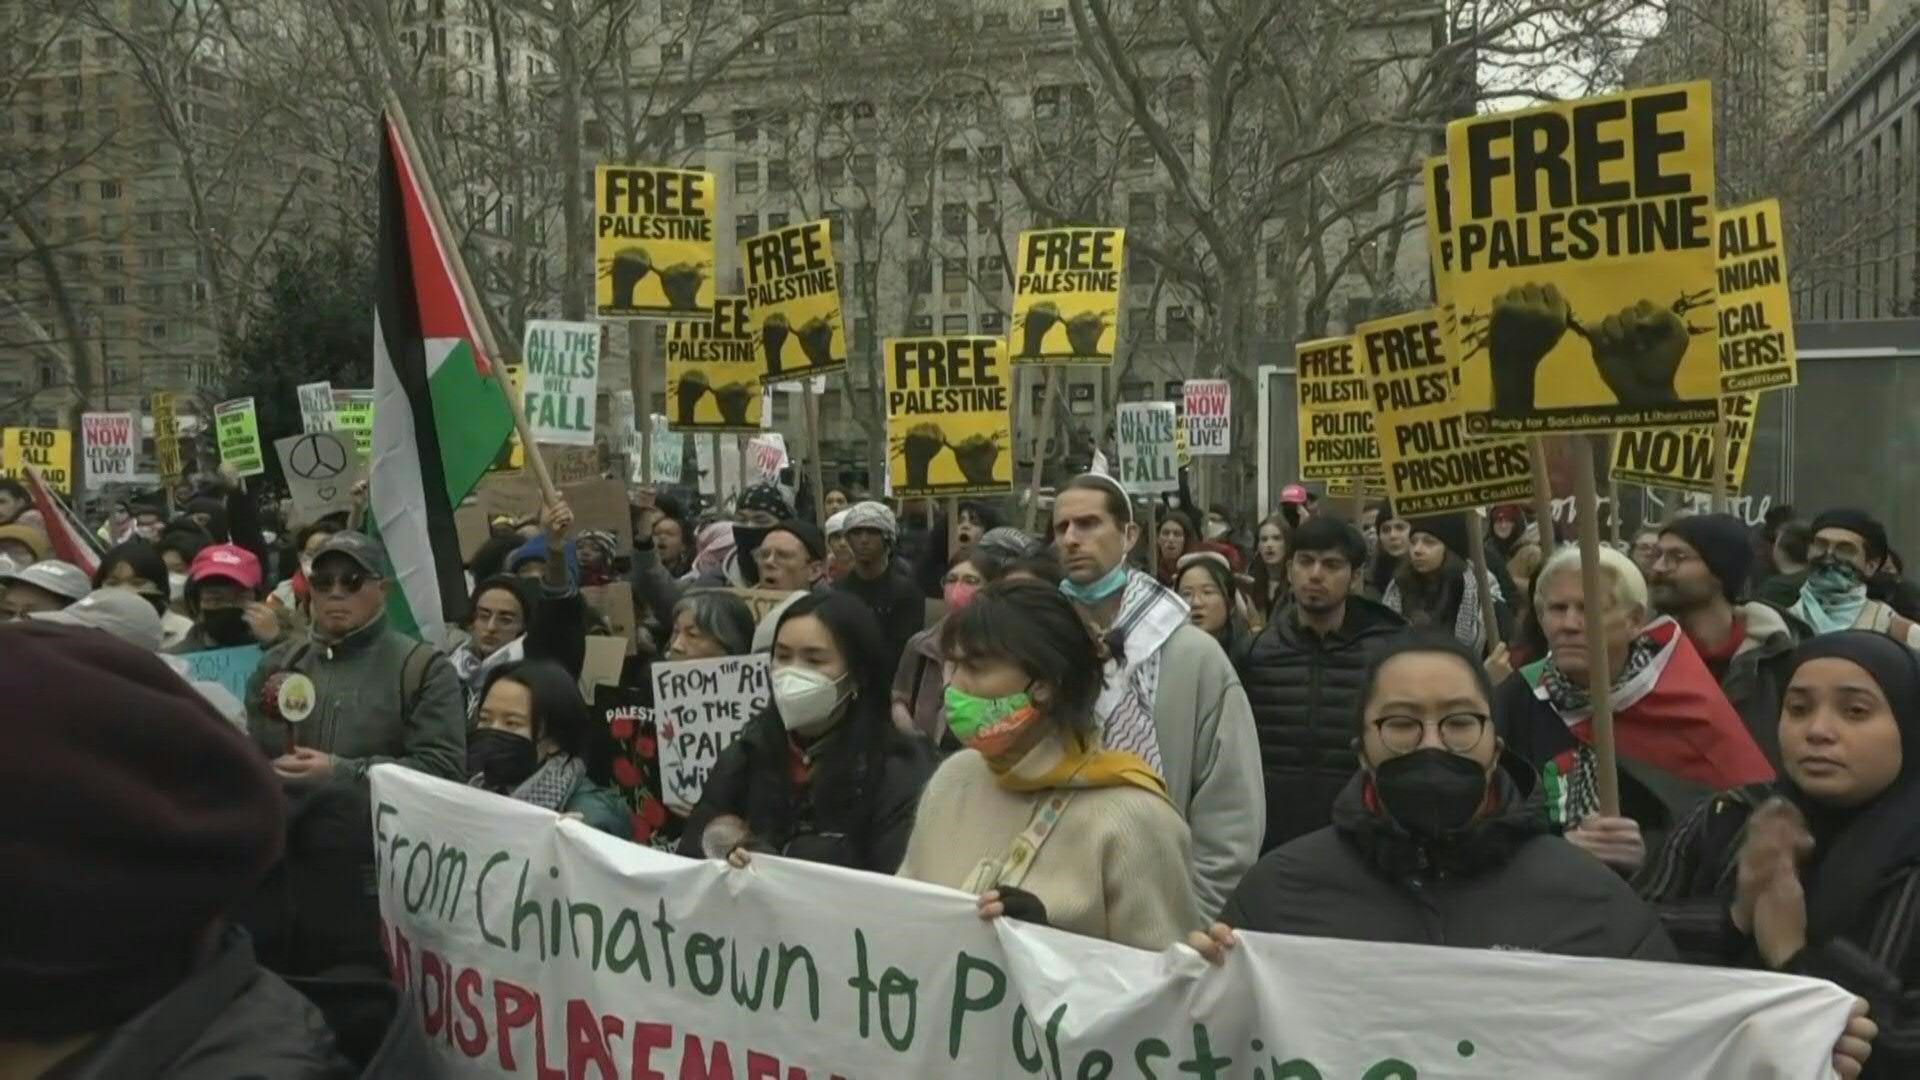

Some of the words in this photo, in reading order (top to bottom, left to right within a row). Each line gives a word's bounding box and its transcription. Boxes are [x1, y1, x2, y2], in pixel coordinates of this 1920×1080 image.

[1467, 91, 1691, 219] FREE
[605, 169, 705, 216] FREE
[599, 215, 711, 242] PALESTINE
[1459, 195, 1710, 272] PALESTINE
[1719, 211, 1777, 260] ALL
[747, 224, 826, 284] FREE
[1026, 231, 1116, 273] FREE
[747, 268, 836, 310] PALESTINE
[1018, 271, 1118, 295] PALESTINE
[528, 328, 559, 350] ALL
[564, 331, 597, 352] THE
[1365, 321, 1446, 376] FREE
[527, 350, 595, 379] WALLS
[894, 340, 1000, 389] FREE
[1300, 345, 1353, 378] FREE
[524, 392, 592, 432] FALL
[890, 387, 1007, 416] PALESTINE
[1187, 397, 1225, 416] NOW
[1615, 411, 1640, 424] and
[18, 430, 55, 448] END
[87, 428, 128, 446] NOW
[1121, 424, 1174, 445] WALLS
[1189, 429, 1223, 447] LIVE!
[1305, 436, 1381, 463] PRISONE
[22, 448, 51, 465] ALL
[1122, 457, 1176, 481] FALL
[1392, 442, 1530, 493] PRISONERS
[1616, 430, 1740, 483] NOW!
[657, 668, 717, 700] FROM
[671, 704, 697, 728] TO
[702, 700, 743, 722] THE
[375, 802, 468, 922] From
[475, 848, 819, 1022] Chinatown
[848, 928, 919, 1052] to
